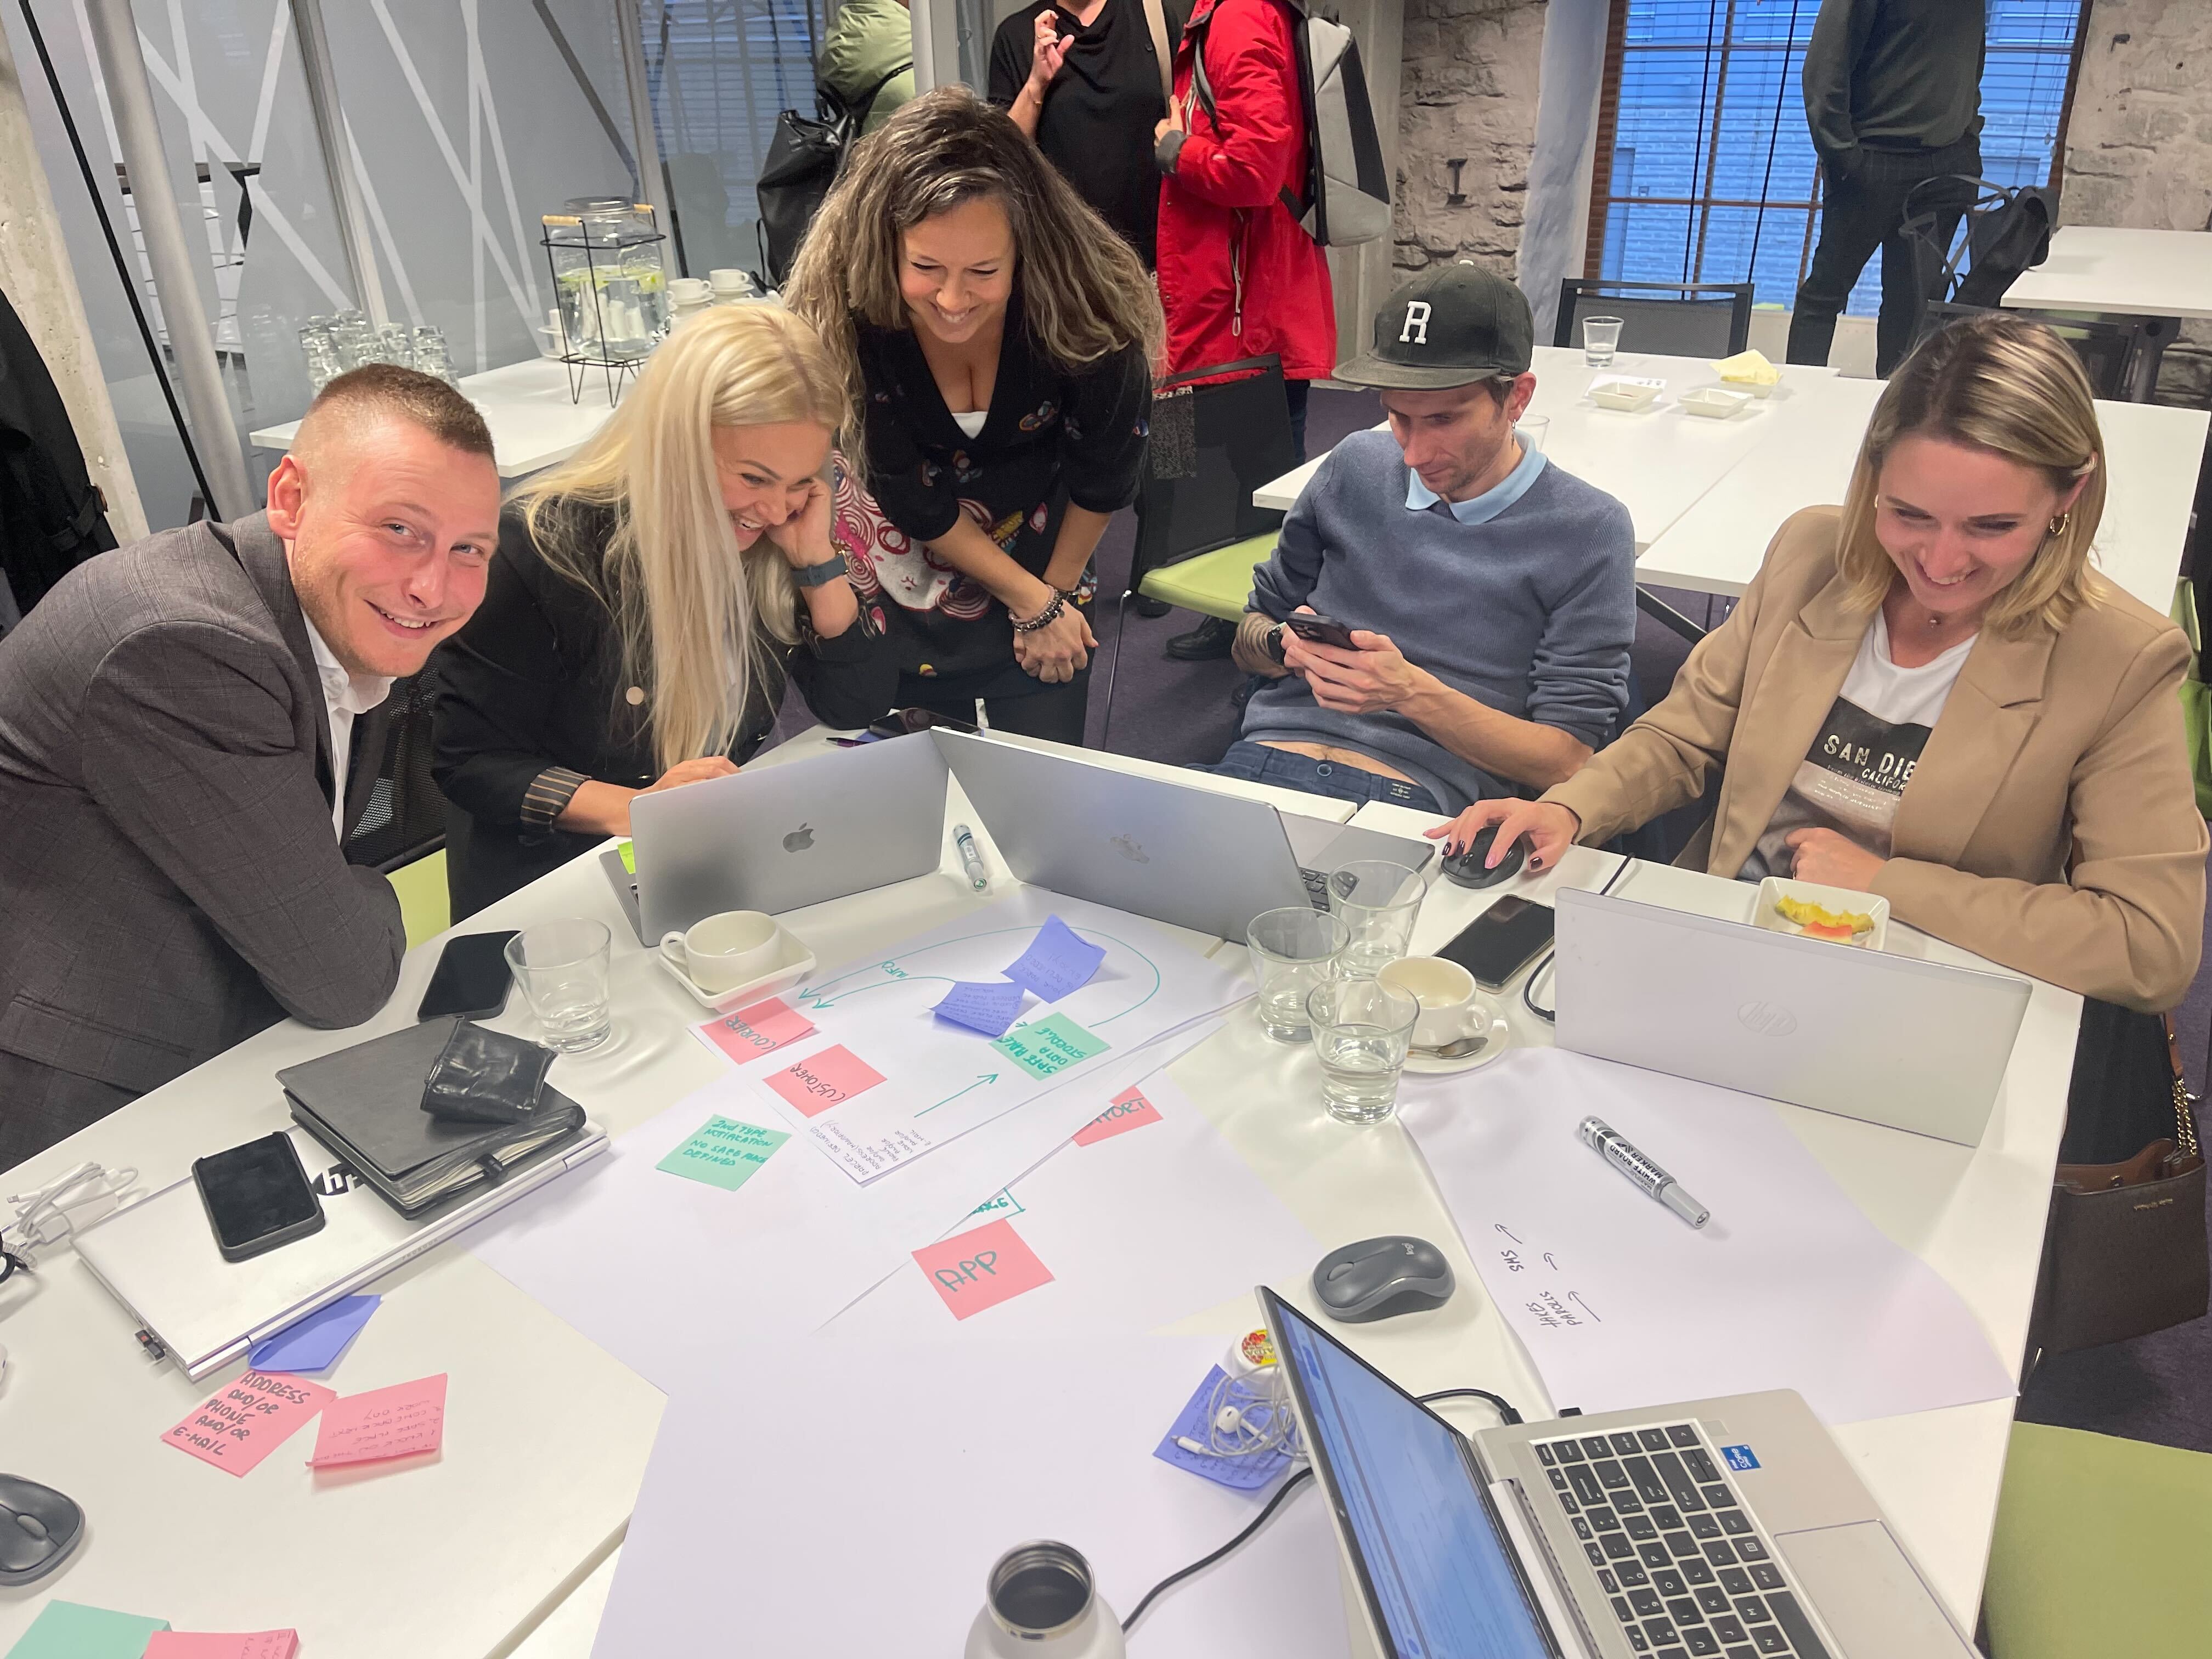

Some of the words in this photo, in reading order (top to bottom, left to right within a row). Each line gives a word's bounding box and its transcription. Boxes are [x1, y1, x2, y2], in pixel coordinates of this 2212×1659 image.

[1399, 301, 1431, 345] R
[1824, 735, 1870, 766] SAN
[882, 961, 910, 979] INFO
[725, 1015, 776, 1050] COURIER
[1023, 1054, 1058, 1074] SAFE
[1039, 1046, 1068, 1065] DATA
[790, 1063, 846, 1102] CUSTOMER
[740, 1126, 768, 1137] TYPE
[682, 1148, 736, 1166] DEFINED
[690, 1140, 708, 1148] NO
[711, 1145, 742, 1157] SAFE
[1631, 1153, 1664, 1178] MARKER
[934, 1250, 997, 1292] APP
[1500, 1250, 1524, 1272] SMS
[1526, 1302, 1561, 1328] TAKES
[240, 1372, 311, 1404] ADDRESS
[205, 1398, 256, 1425] PHONE
[228, 1389, 279, 1414] AND/OR
[173, 1427, 226, 1455] E-MAIL
